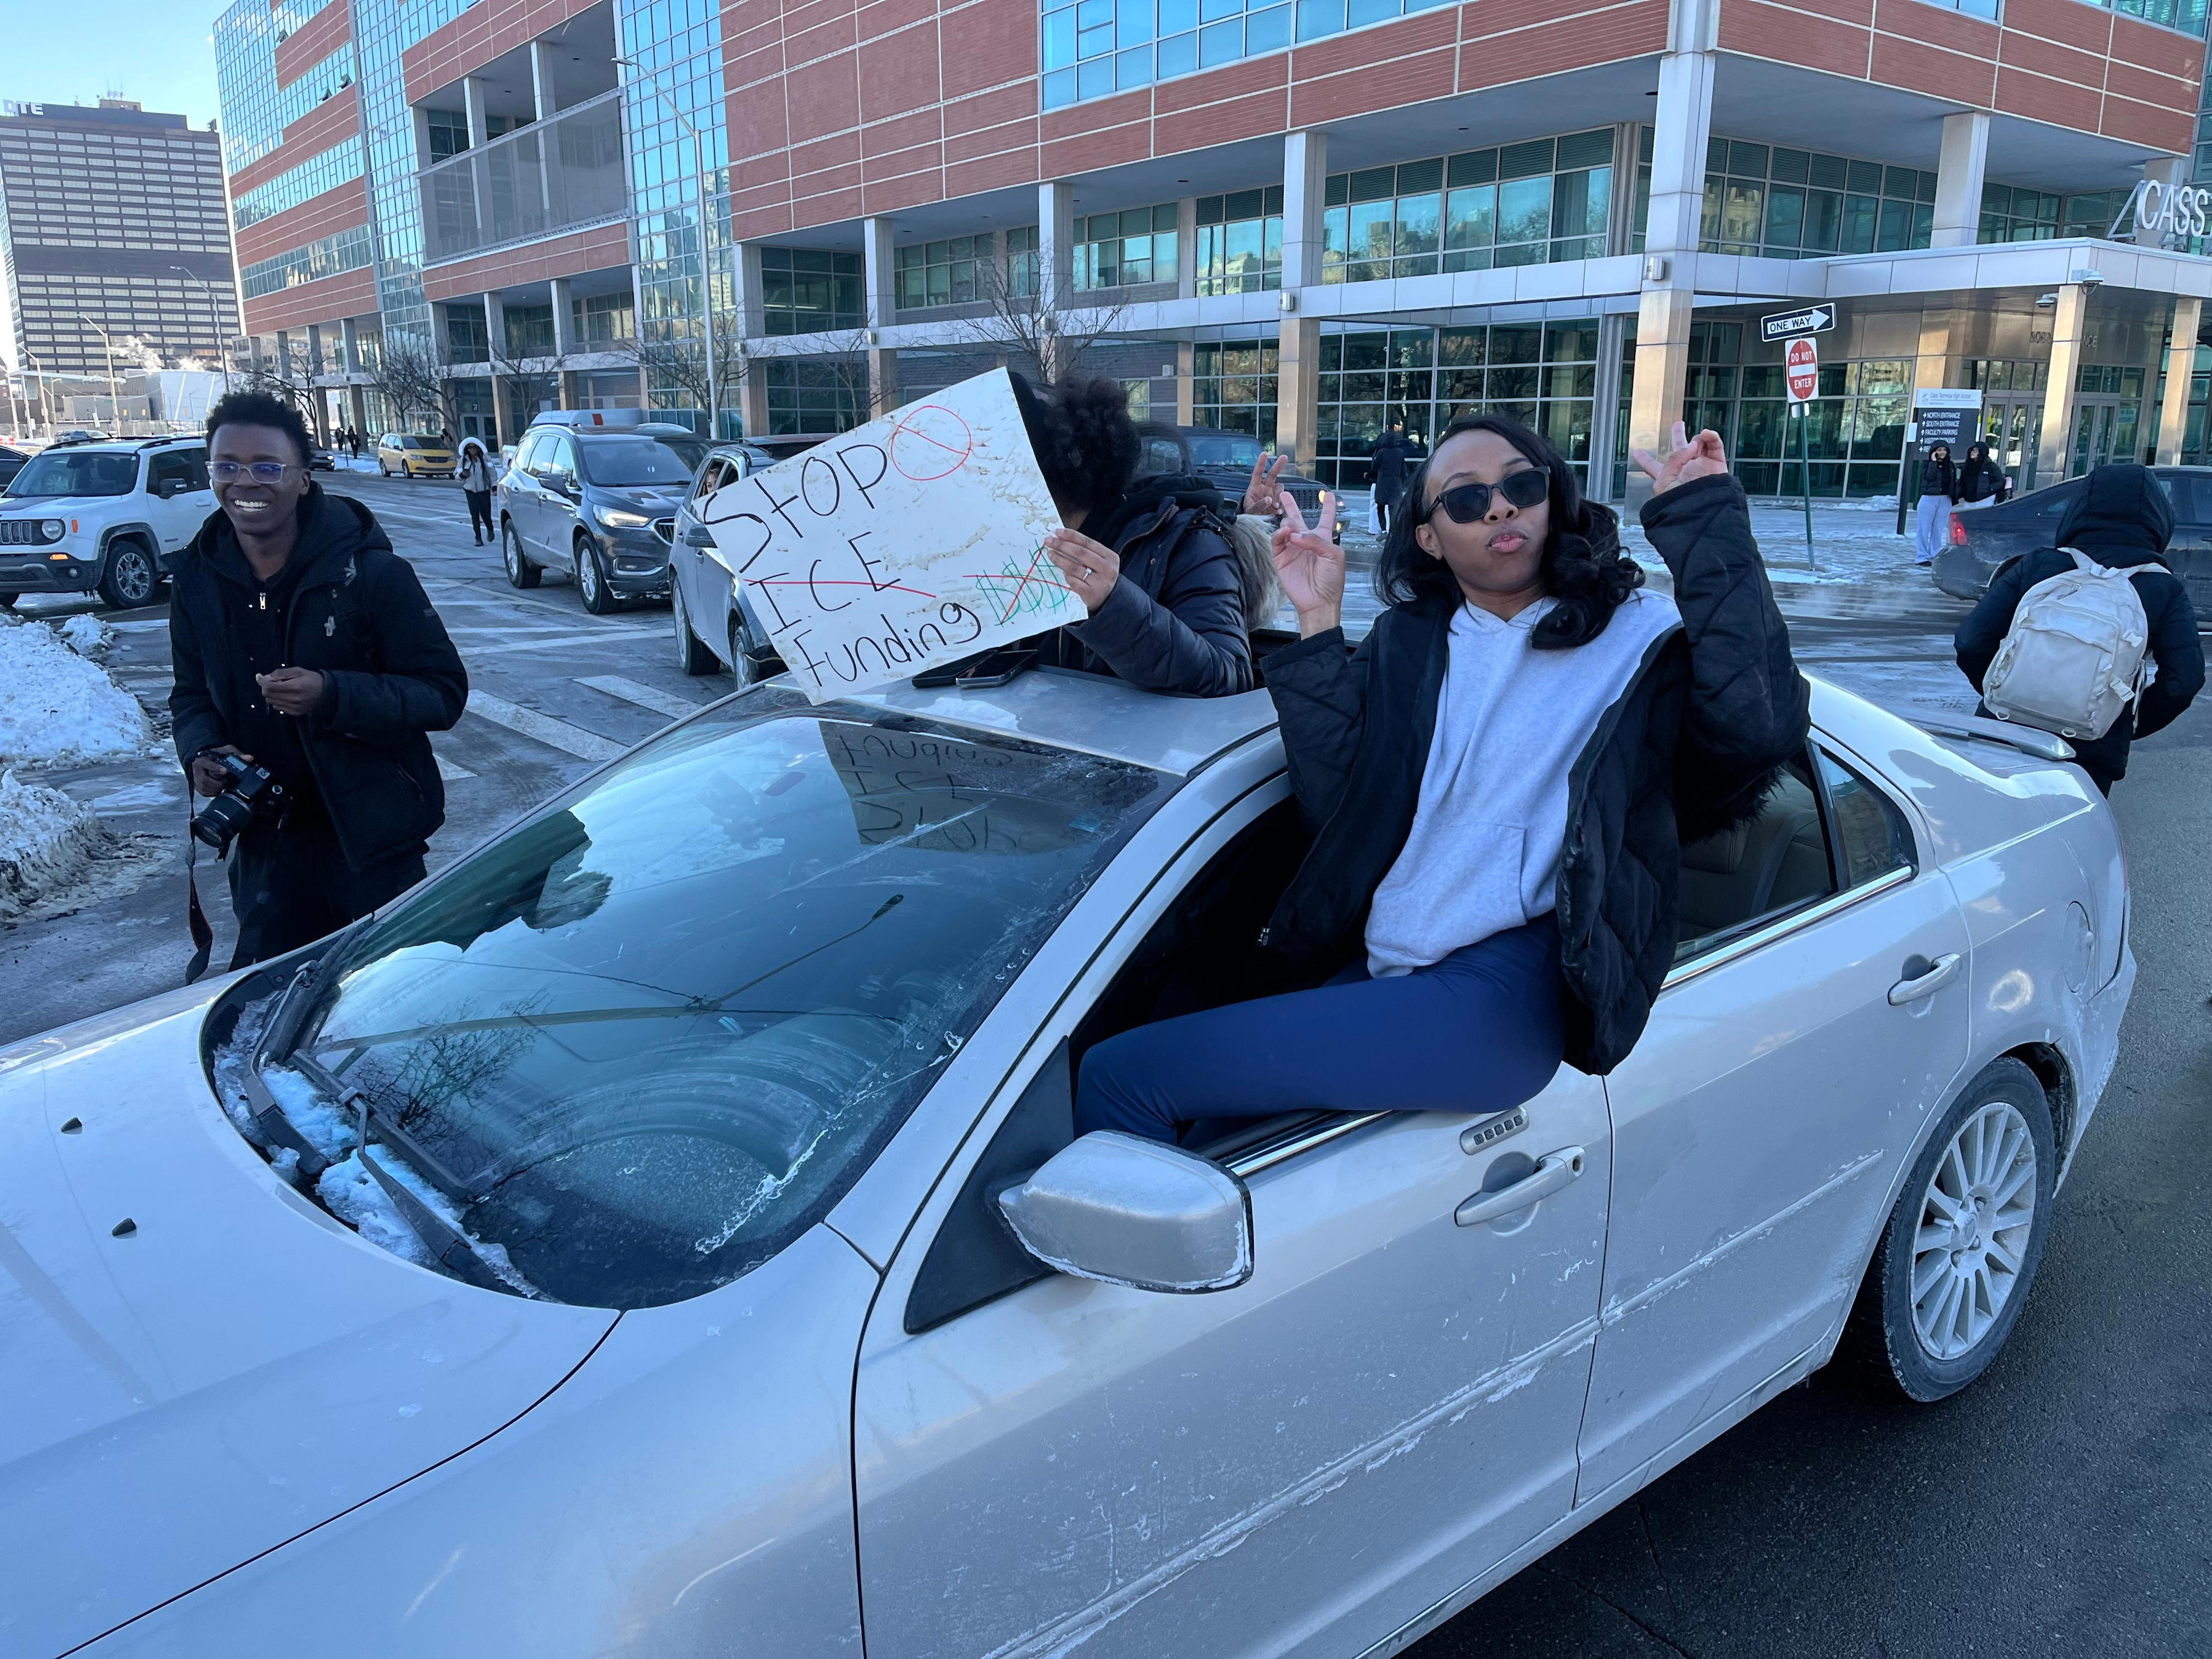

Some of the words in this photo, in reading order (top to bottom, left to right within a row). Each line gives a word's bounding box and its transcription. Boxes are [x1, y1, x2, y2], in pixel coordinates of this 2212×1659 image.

[2138, 179, 2208, 237] CASS
[1770, 321, 1789, 332] ONE
[1792, 316, 1812, 328] WAY
[1791, 353, 1800, 363] DO
[1801, 350, 1813, 361] NOT
[1794, 377, 1812, 389] ENTER
[704, 444, 888, 573] STOP
[793, 602, 981, 687] Funding
